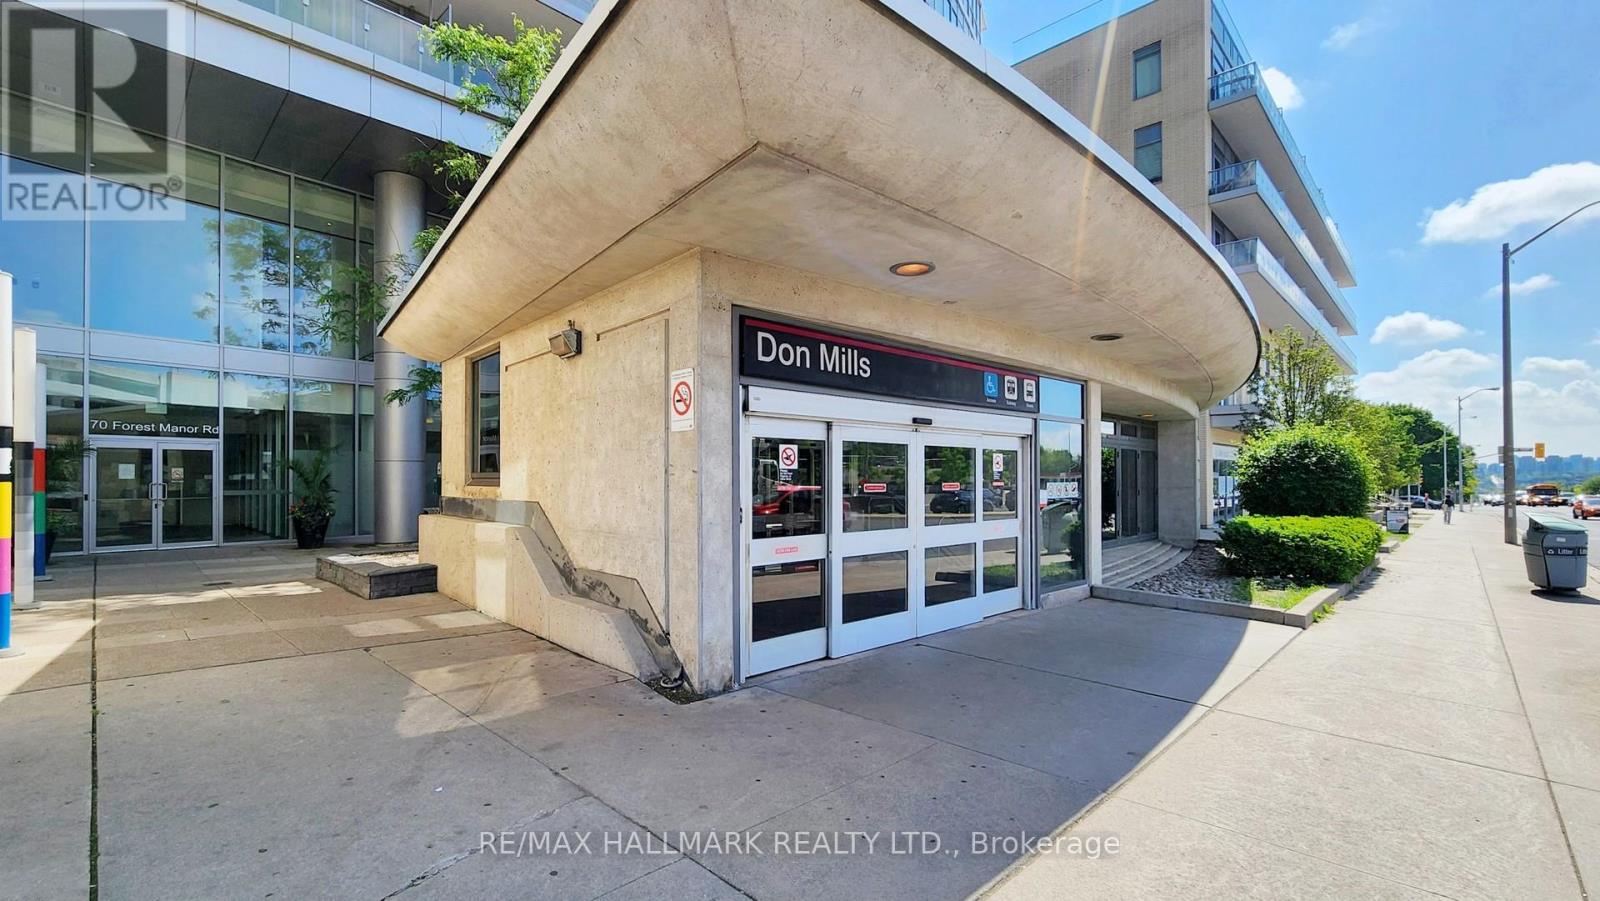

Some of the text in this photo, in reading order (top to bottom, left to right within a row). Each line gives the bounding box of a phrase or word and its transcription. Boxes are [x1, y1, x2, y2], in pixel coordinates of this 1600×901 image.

[757, 330, 871, 378] Don Mills
[90, 420, 219, 434] 70 Forest Manor Rd
